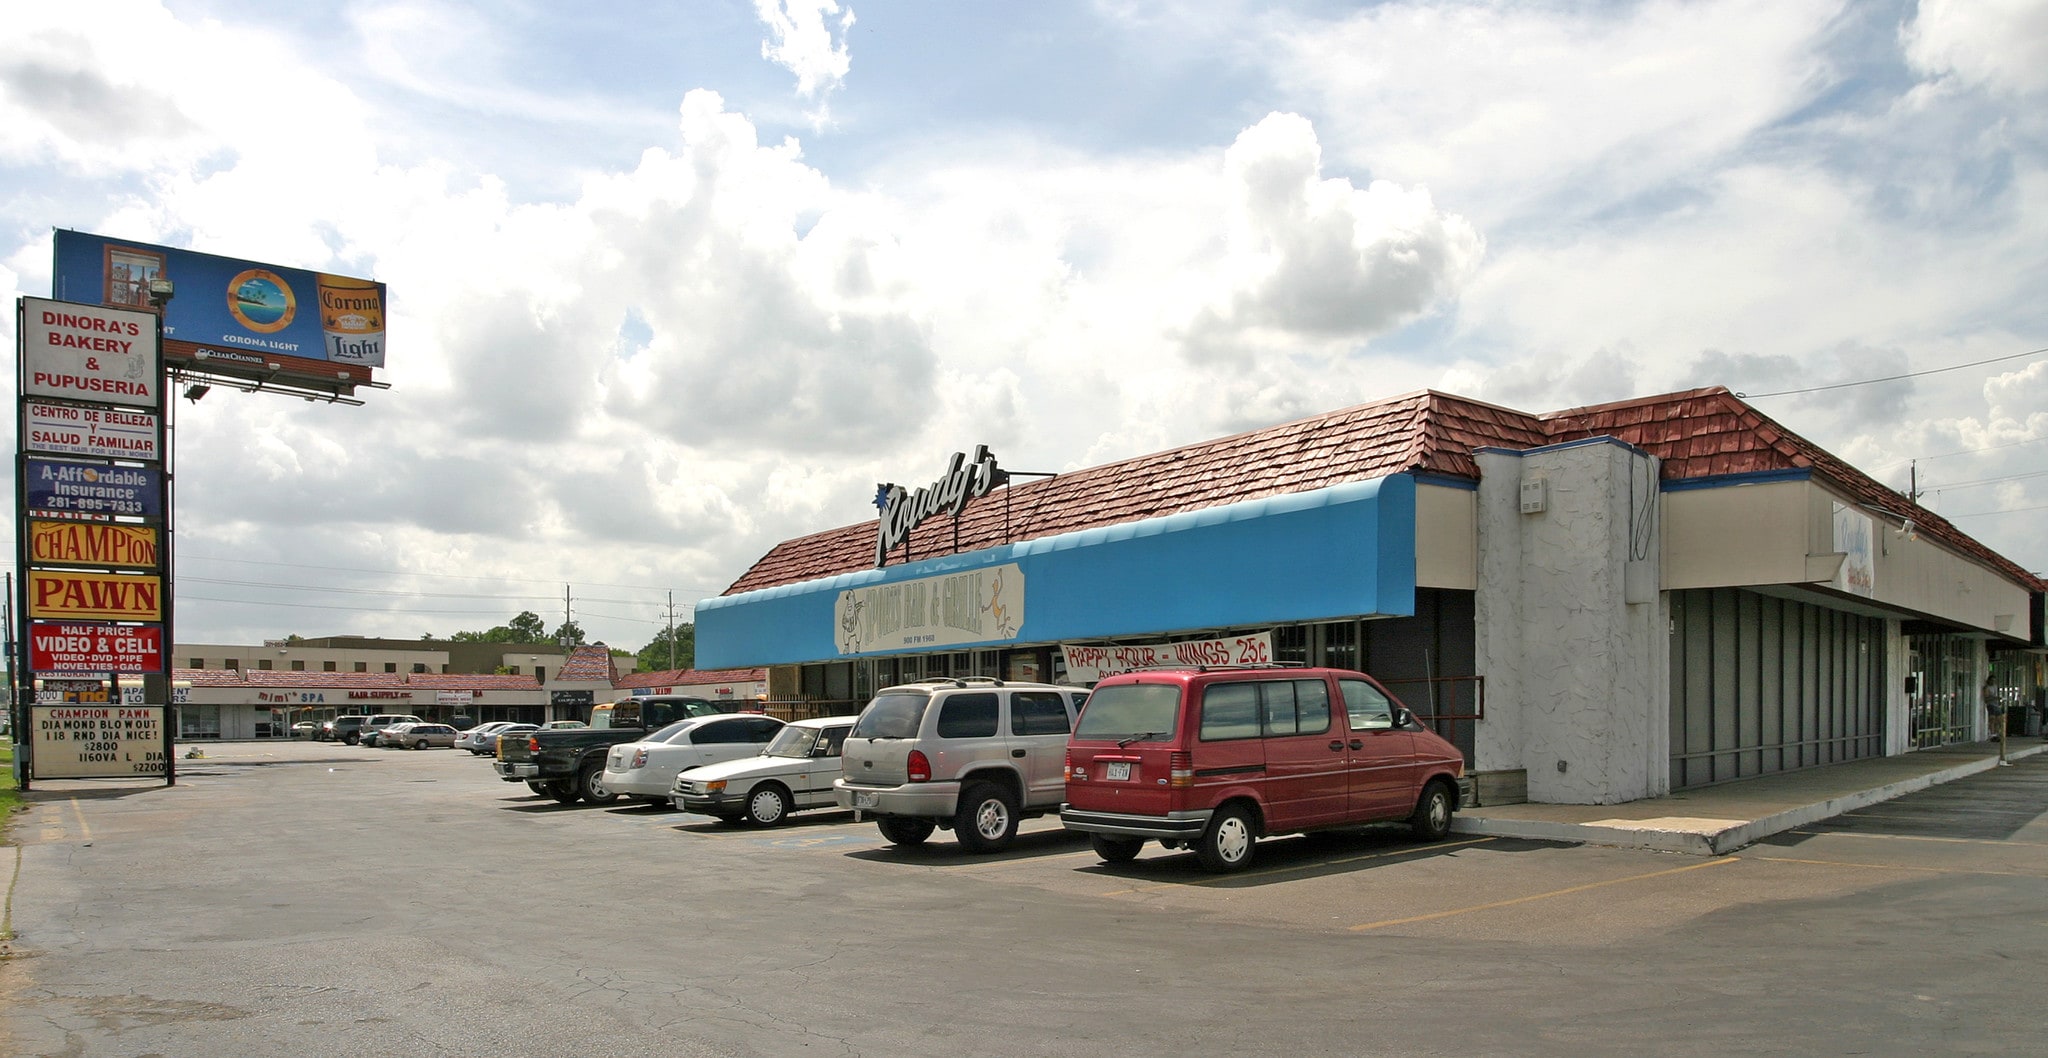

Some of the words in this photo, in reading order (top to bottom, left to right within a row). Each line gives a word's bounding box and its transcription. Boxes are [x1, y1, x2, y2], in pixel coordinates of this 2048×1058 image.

[322, 288, 379, 312] Corona
[42, 311, 139, 336] DINORA'S
[48, 332, 132, 354] BAKERY
[222, 334, 267, 347] CORONA
[269, 341, 299, 351] LIGHT
[331, 335, 379, 359] Light
[85, 357, 100, 371] &
[34, 372, 149, 397] PUPUSERIA
[32, 405, 79, 420] CENTRO
[84, 411, 99, 422] DE
[104, 412, 153, 427] BELLEZA
[90, 423, 97, 434] Y
[32, 430, 80, 445] SALUD
[88, 435, 153, 451] FAMILIAR
[32, 442, 46, 450] THE
[49, 444, 68, 452] BEST
[71, 445, 88, 453] HAIR
[108, 448, 126, 456] LESS
[129, 450, 153, 459] MONEY
[54, 481, 134, 499] Insurance
[47, 496, 143, 512] 281-895-7333
[34, 524, 156, 564] CHAMPION
[35, 578, 157, 611] PAWN
[904, 582, 926, 628] BAR
[943, 573, 983, 636] GRILLE
[60, 625, 94, 635] HALF
[97, 626, 134, 636] PRICE
[36, 636, 91, 653] VIDEO
[96, 637, 109, 653] &
[114, 638, 157, 654] CELL
[903, 636, 913, 644] 900
[51, 653, 86, 661] VIDEO
[91, 654, 113, 662] DVD
[120, 654, 143, 662] PIPE
[1066, 646, 1112, 668] HAPPY
[1115, 646, 1160, 667] HOUR
[1174, 640, 1230, 666] WINGS
[53, 662, 114, 671] NOVELTIES
[120, 663, 142, 671] GAG
[301, 692, 324, 703] SPA
[348, 691, 369, 699] HAIR
[370, 691, 400, 699] SUPPLY
[50, 709, 109, 719] CHAMPION
[119, 709, 150, 719] PAWN
[42, 720, 96, 730] DIAMOND
[100, 719, 157, 729] BLOWOUT
[74, 730, 96, 740] RND
[102, 730, 121, 740] DIA
[126, 730, 157, 740] NICE!
[84, 742, 118, 751] $2800
[146, 752, 164, 761] DIA
[133, 763, 165, 772] $2200
